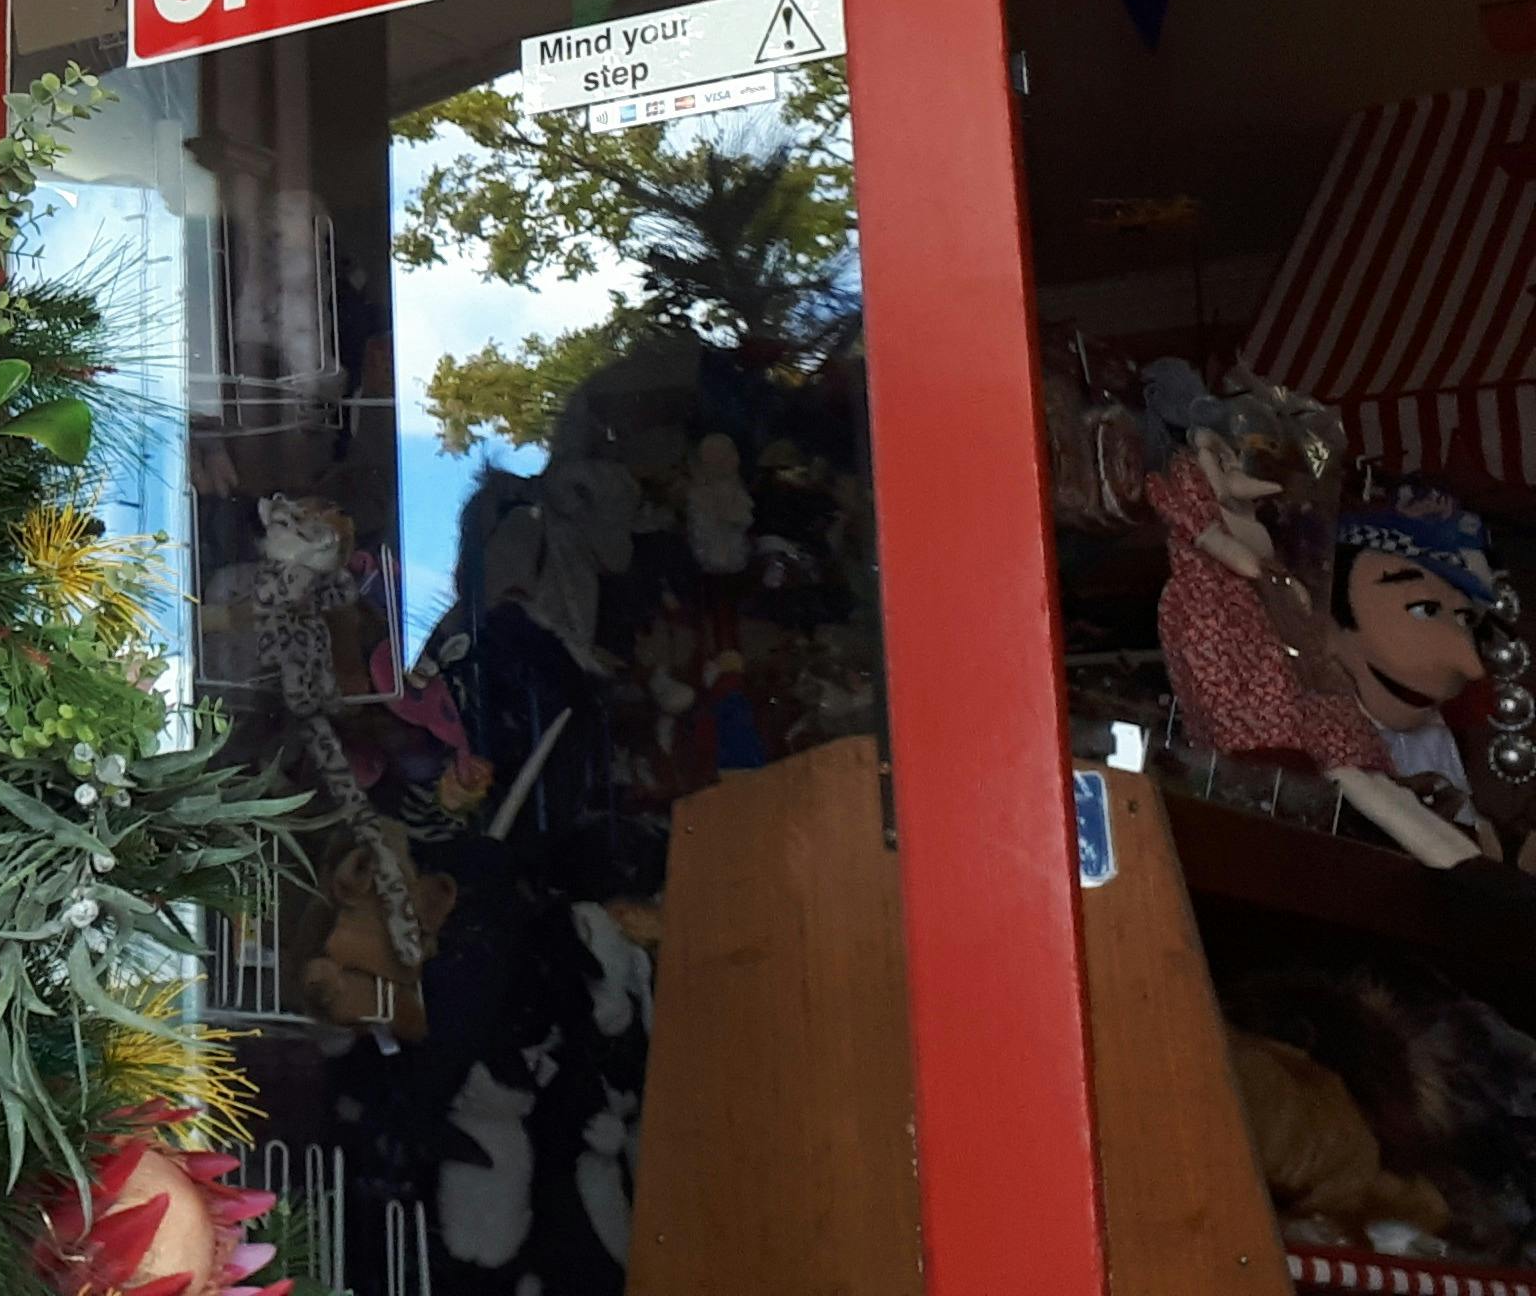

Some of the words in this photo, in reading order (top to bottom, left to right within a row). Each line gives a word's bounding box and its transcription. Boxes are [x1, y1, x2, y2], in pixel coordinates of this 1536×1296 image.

[539, 26, 612, 66] Mind
[622, 18, 691, 55] your
[583, 60, 649, 93] step
[704, 90, 732, 103] VISA
